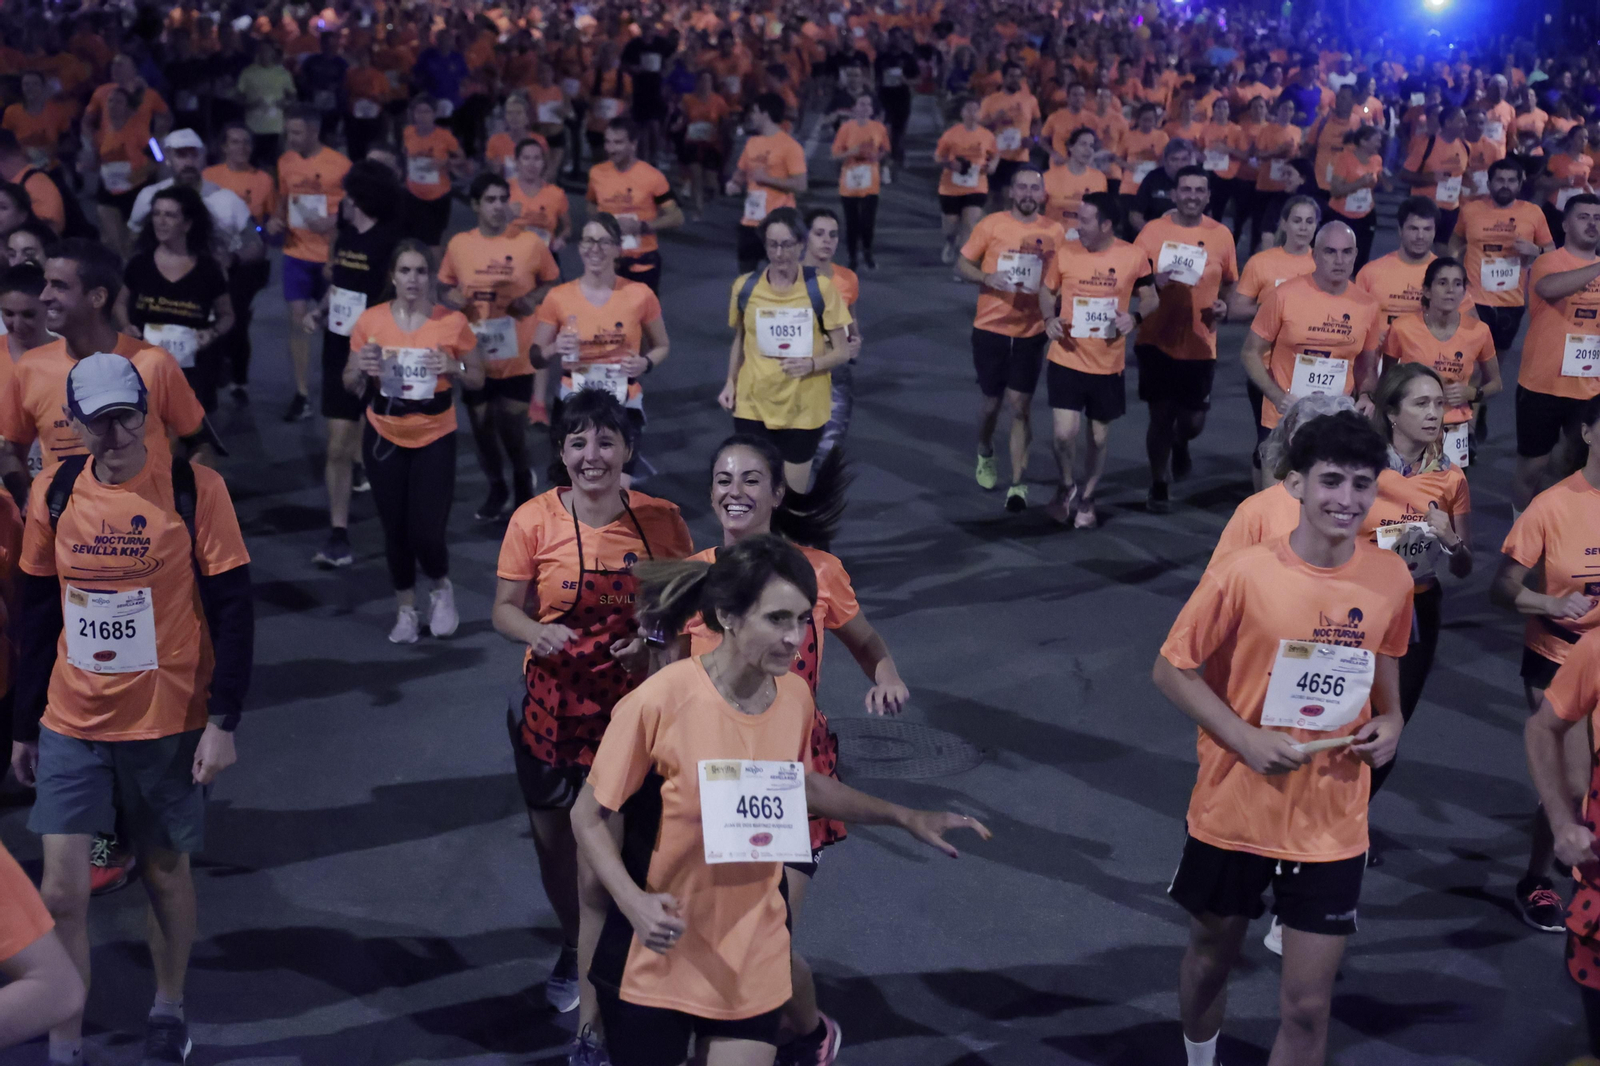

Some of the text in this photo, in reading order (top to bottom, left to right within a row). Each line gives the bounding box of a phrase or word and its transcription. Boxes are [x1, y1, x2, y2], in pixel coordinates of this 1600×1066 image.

[1172, 254, 1194, 268] 3640
[1010, 266, 1031, 276] 3641
[1085, 312, 1108, 322] 3643
[769, 325, 802, 337] 10831
[392, 365, 427, 378] 10040
[1308, 372, 1335, 386] 8127
[94, 535, 151, 546] NOCTURNA
[71, 544, 118, 556] SEVILLA
[79, 617, 136, 640] 21685
[1313, 628, 1365, 640] NOCTURNA
[1296, 672, 1346, 697] 4656
[736, 795, 784, 820] 4663
